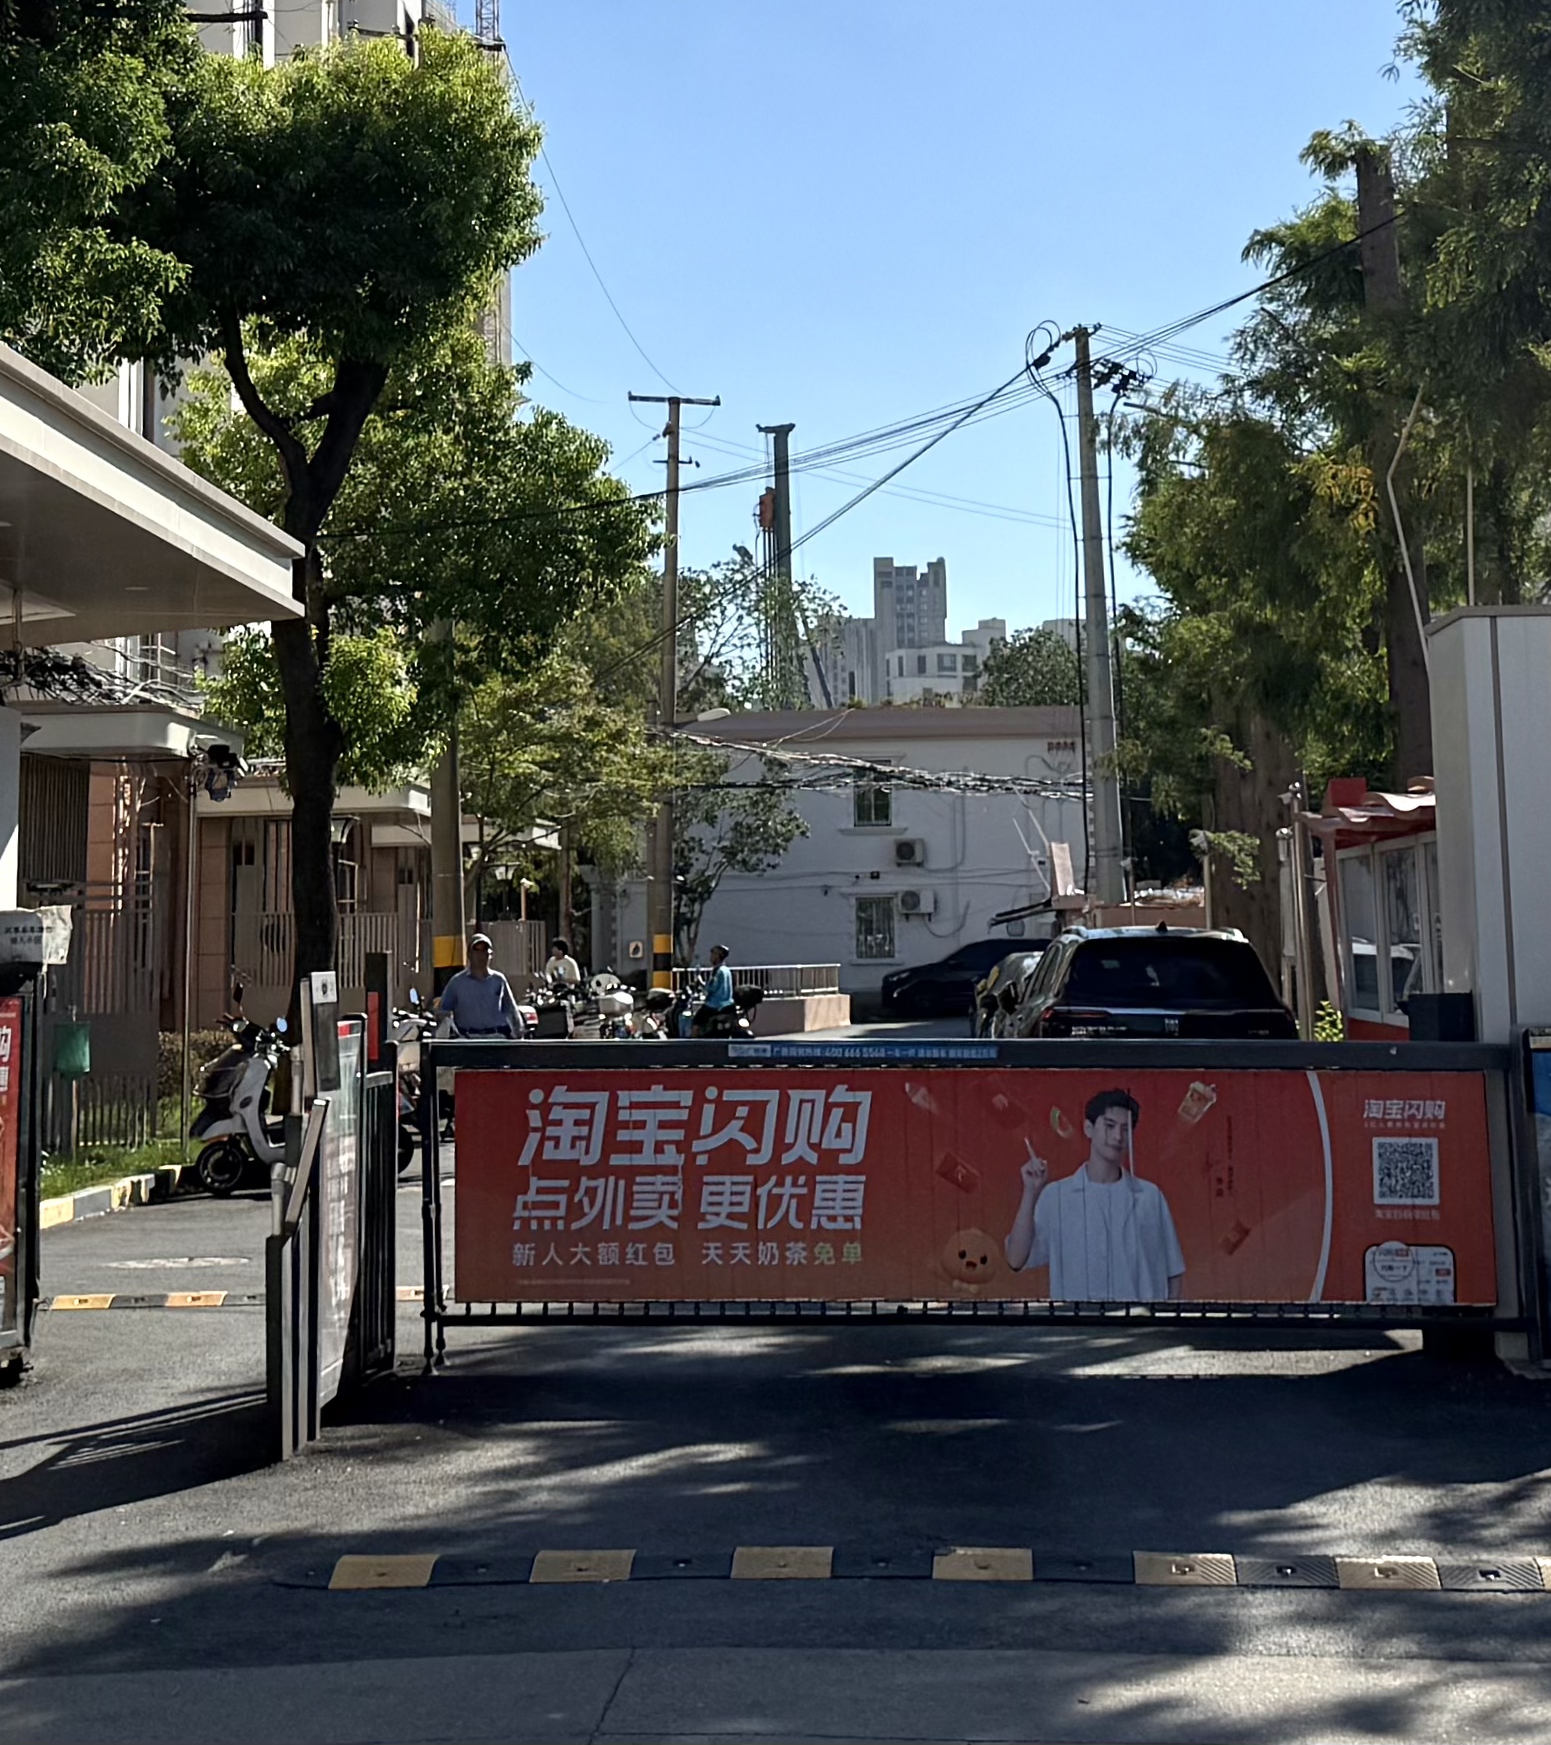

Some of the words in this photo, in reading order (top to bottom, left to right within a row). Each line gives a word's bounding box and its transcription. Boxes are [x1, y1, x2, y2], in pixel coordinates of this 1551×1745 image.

[517, 1085, 872, 1165] 淘宝闪购
[1363, 1099, 1446, 1120] 淘宝闪购
[513, 1175, 680, 1230] 点外卖
[697, 1175, 866, 1230] 更优惠
[512, 1242, 676, 1266] 新人大额红包
[701, 1242, 863, 1266] 天天奶茶免单
